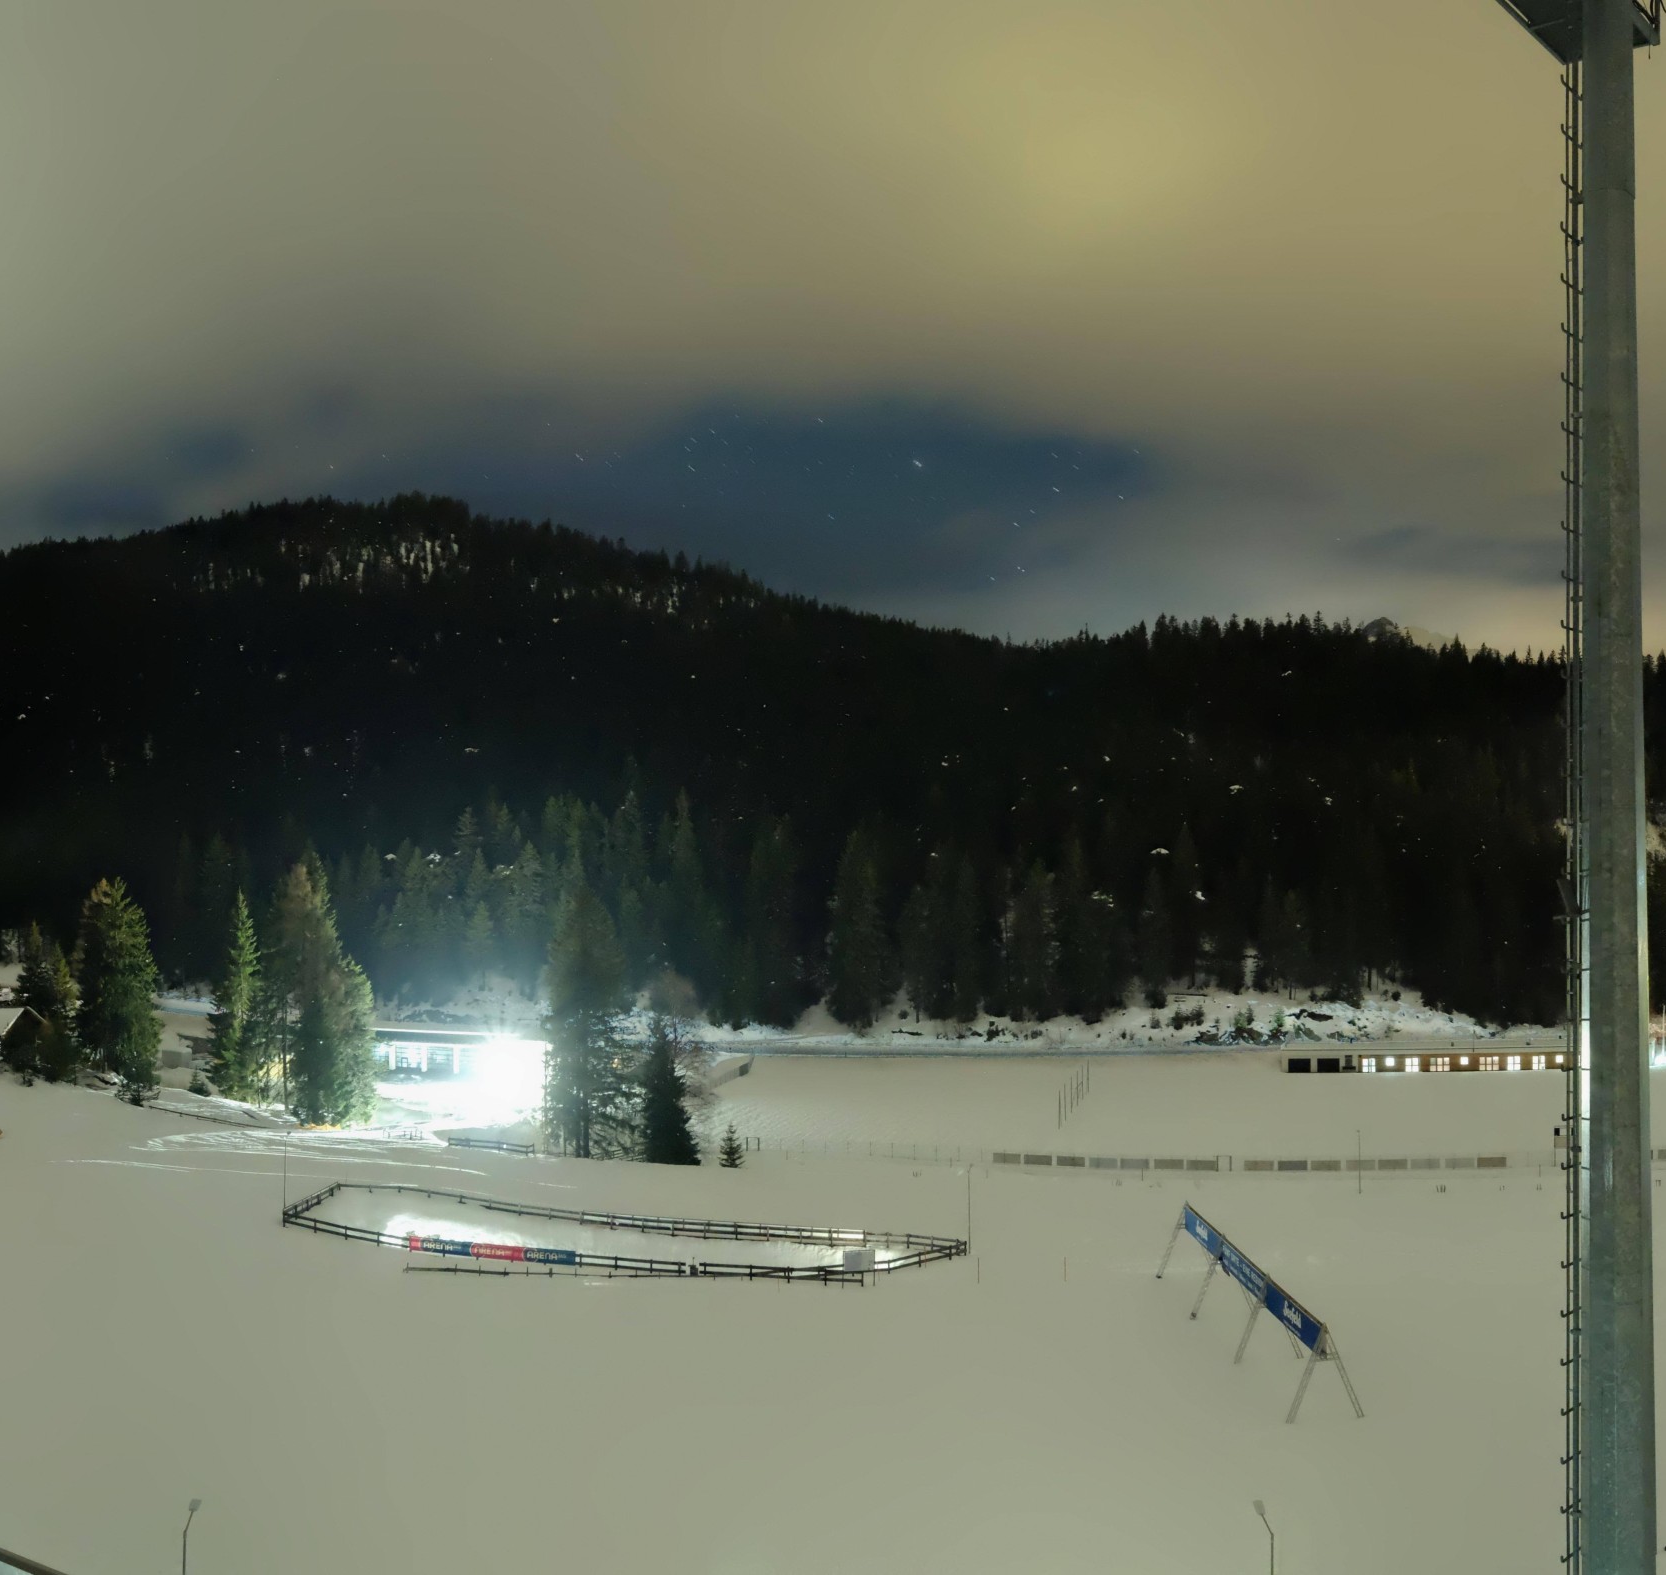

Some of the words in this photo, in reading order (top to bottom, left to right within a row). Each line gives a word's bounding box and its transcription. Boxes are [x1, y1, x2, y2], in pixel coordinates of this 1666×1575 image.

[423, 1241, 453, 1251] ARENA
[474, 1246, 505, 1256] ARENA
[526, 1250, 558, 1260] ARENA
[1283, 1300, 1301, 1329] Seefeld
